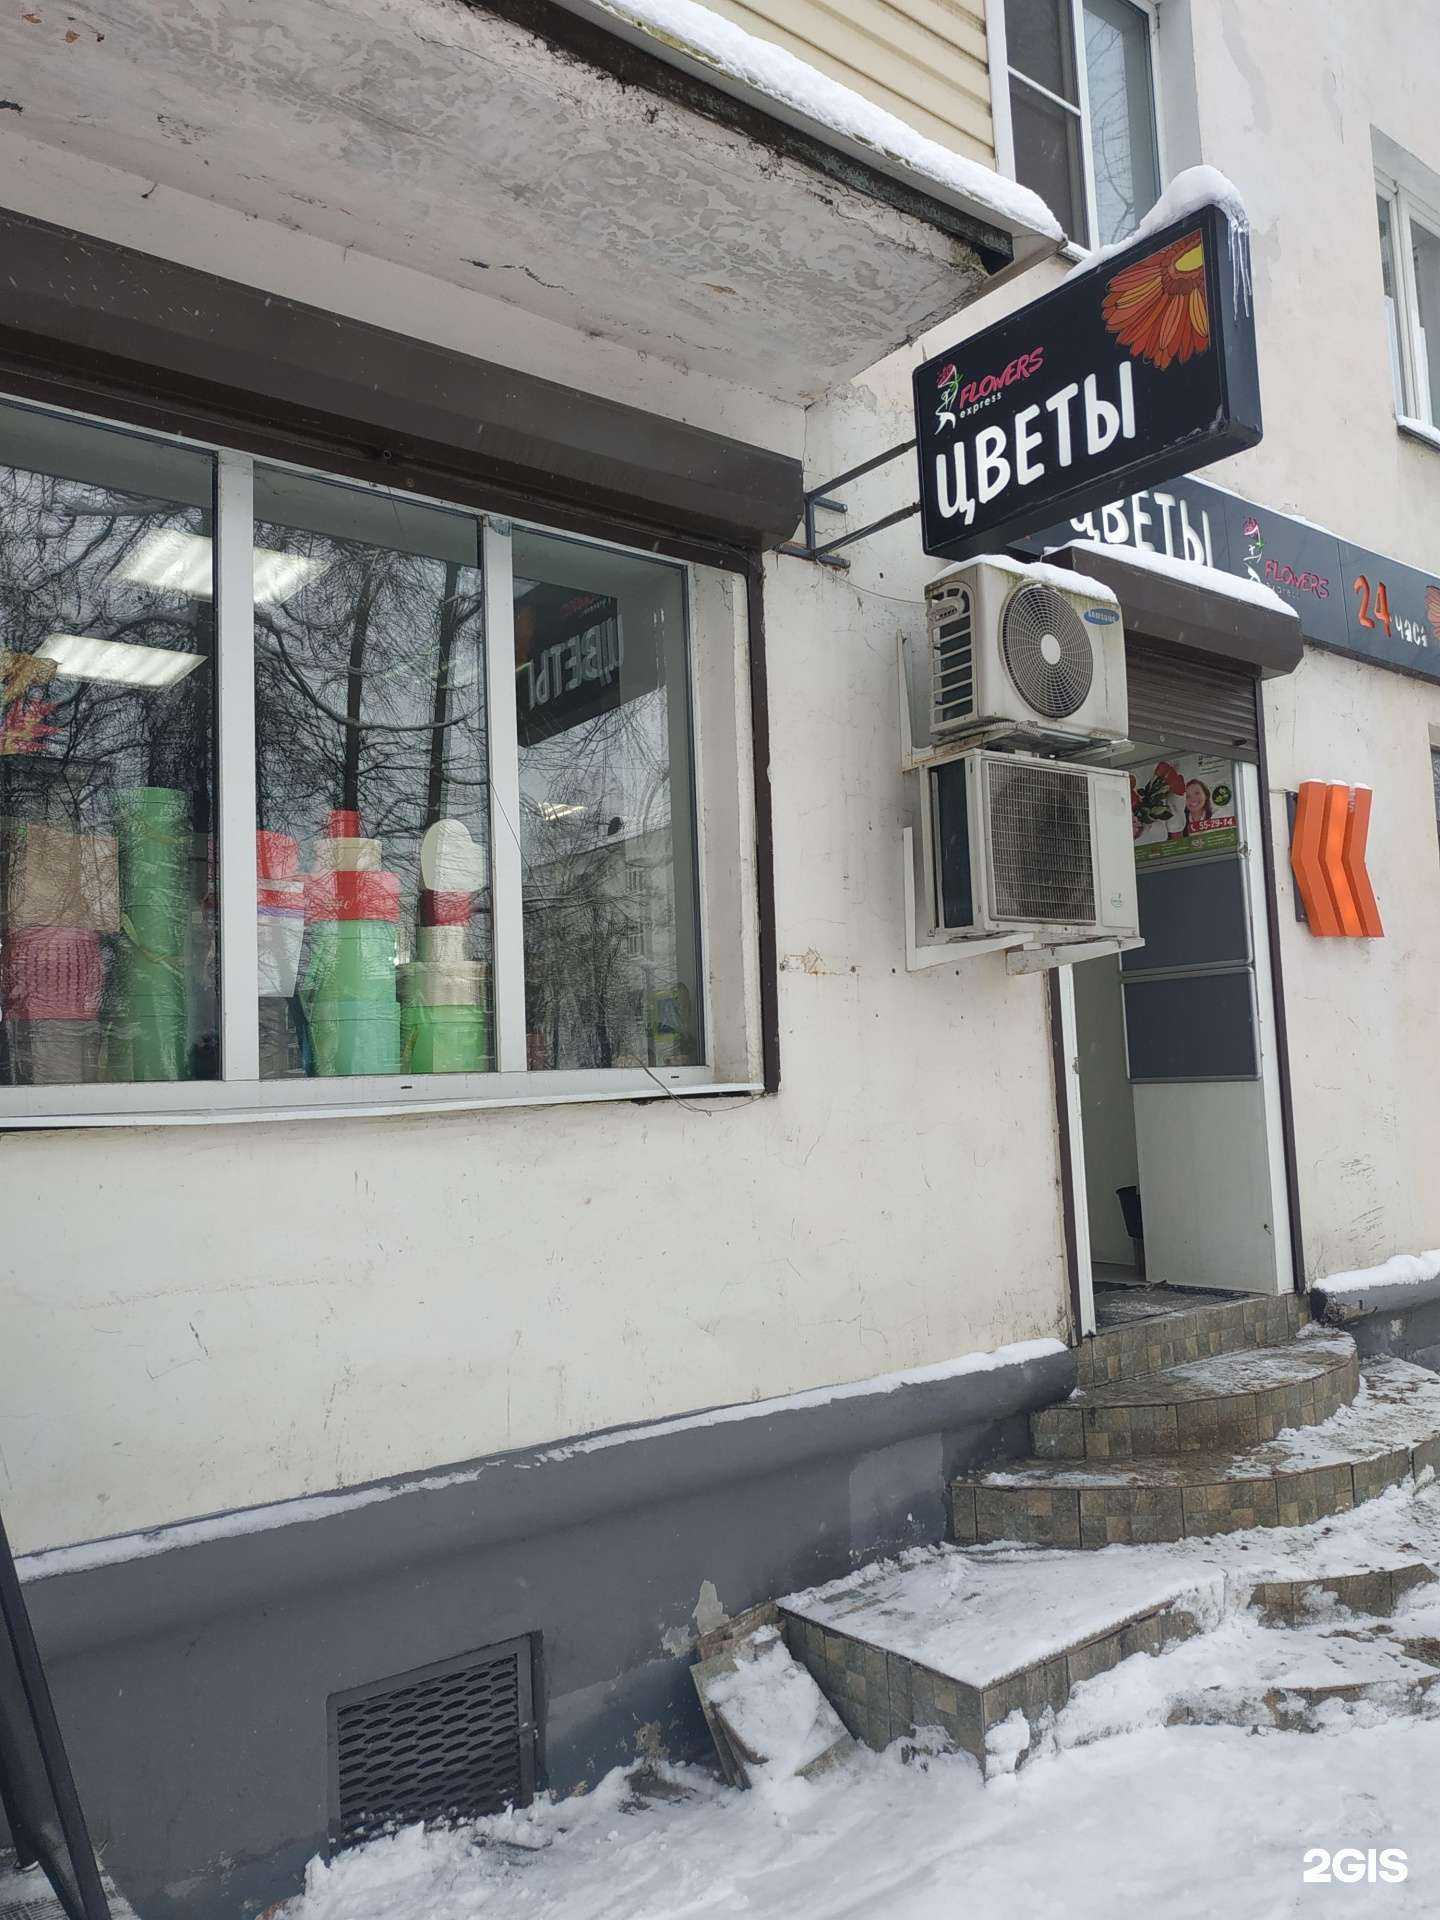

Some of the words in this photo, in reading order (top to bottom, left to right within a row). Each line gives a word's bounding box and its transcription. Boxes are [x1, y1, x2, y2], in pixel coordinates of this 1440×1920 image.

[959, 346, 1045, 409] FLOWERS
[960, 392, 1002, 418] express
[935, 361, 1136, 525] ЦВЕТЫ
[1265, 560, 1329, 600] FLOWERS
[1354, 575, 1392, 638] 24
